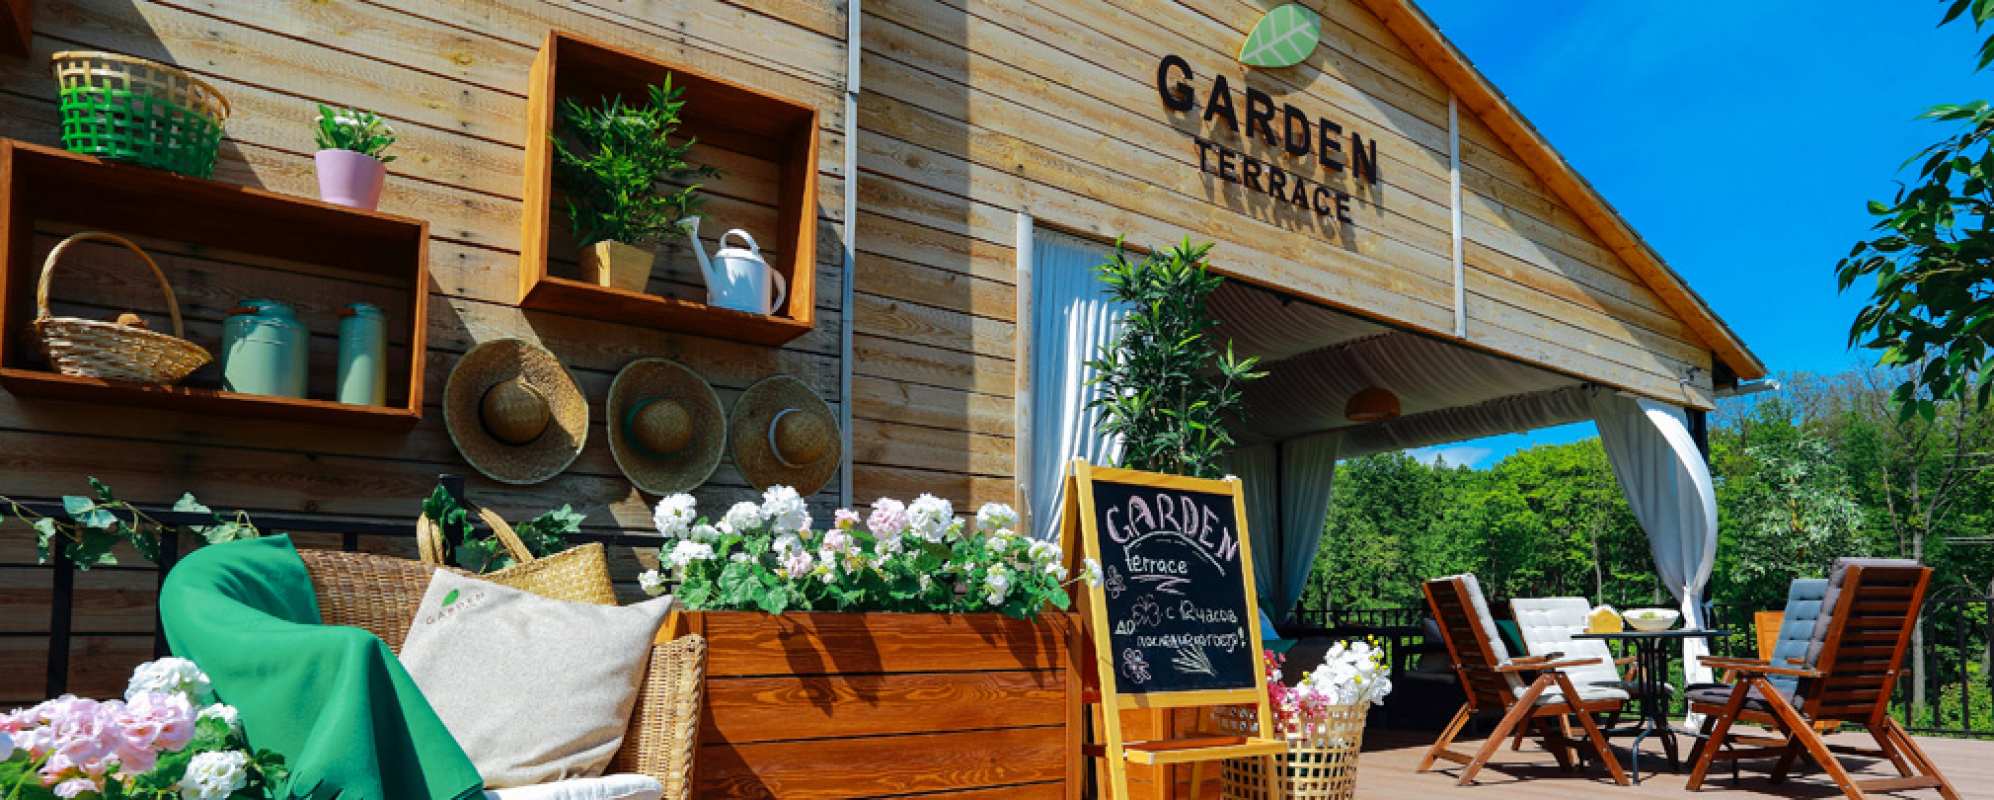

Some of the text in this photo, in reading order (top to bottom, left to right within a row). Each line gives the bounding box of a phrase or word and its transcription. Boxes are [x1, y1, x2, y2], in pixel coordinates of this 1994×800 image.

[1158, 54, 1377, 185] GARDEN
[1194, 136, 1353, 225] TERRACE
[1106, 493, 1239, 562] GARDEN
